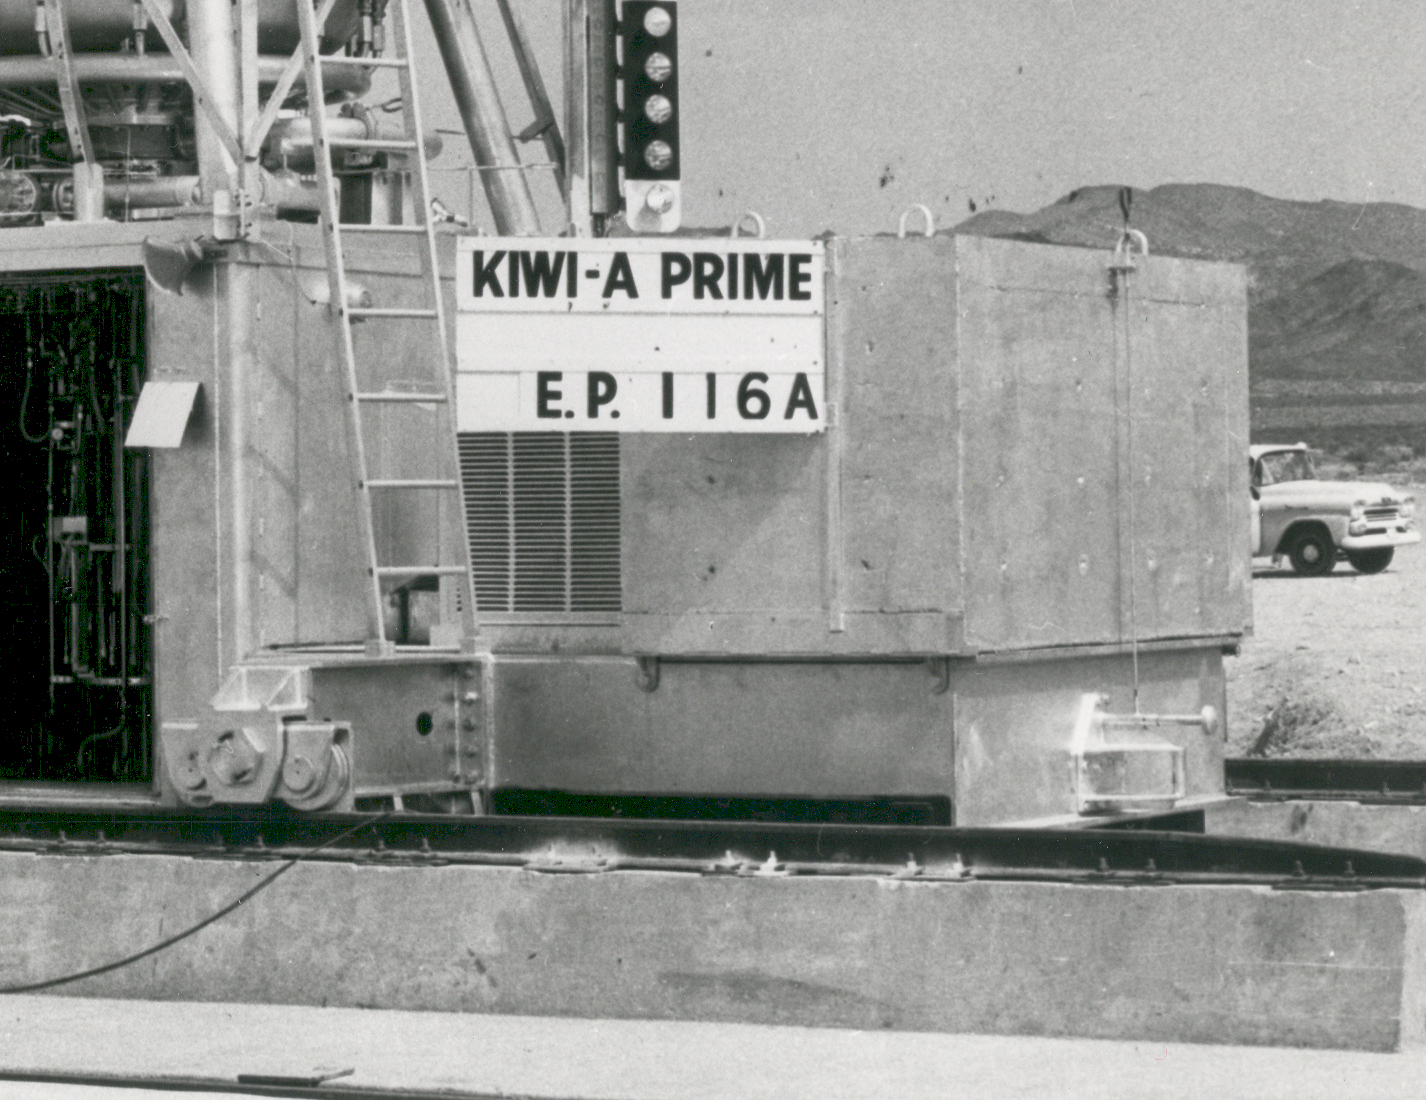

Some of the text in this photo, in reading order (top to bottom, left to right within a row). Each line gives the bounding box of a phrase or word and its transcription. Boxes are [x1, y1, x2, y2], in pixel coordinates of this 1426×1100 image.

[473, 250, 813, 301] KIWI-A PRIME
[536, 371, 819, 420] E.P. 116A
